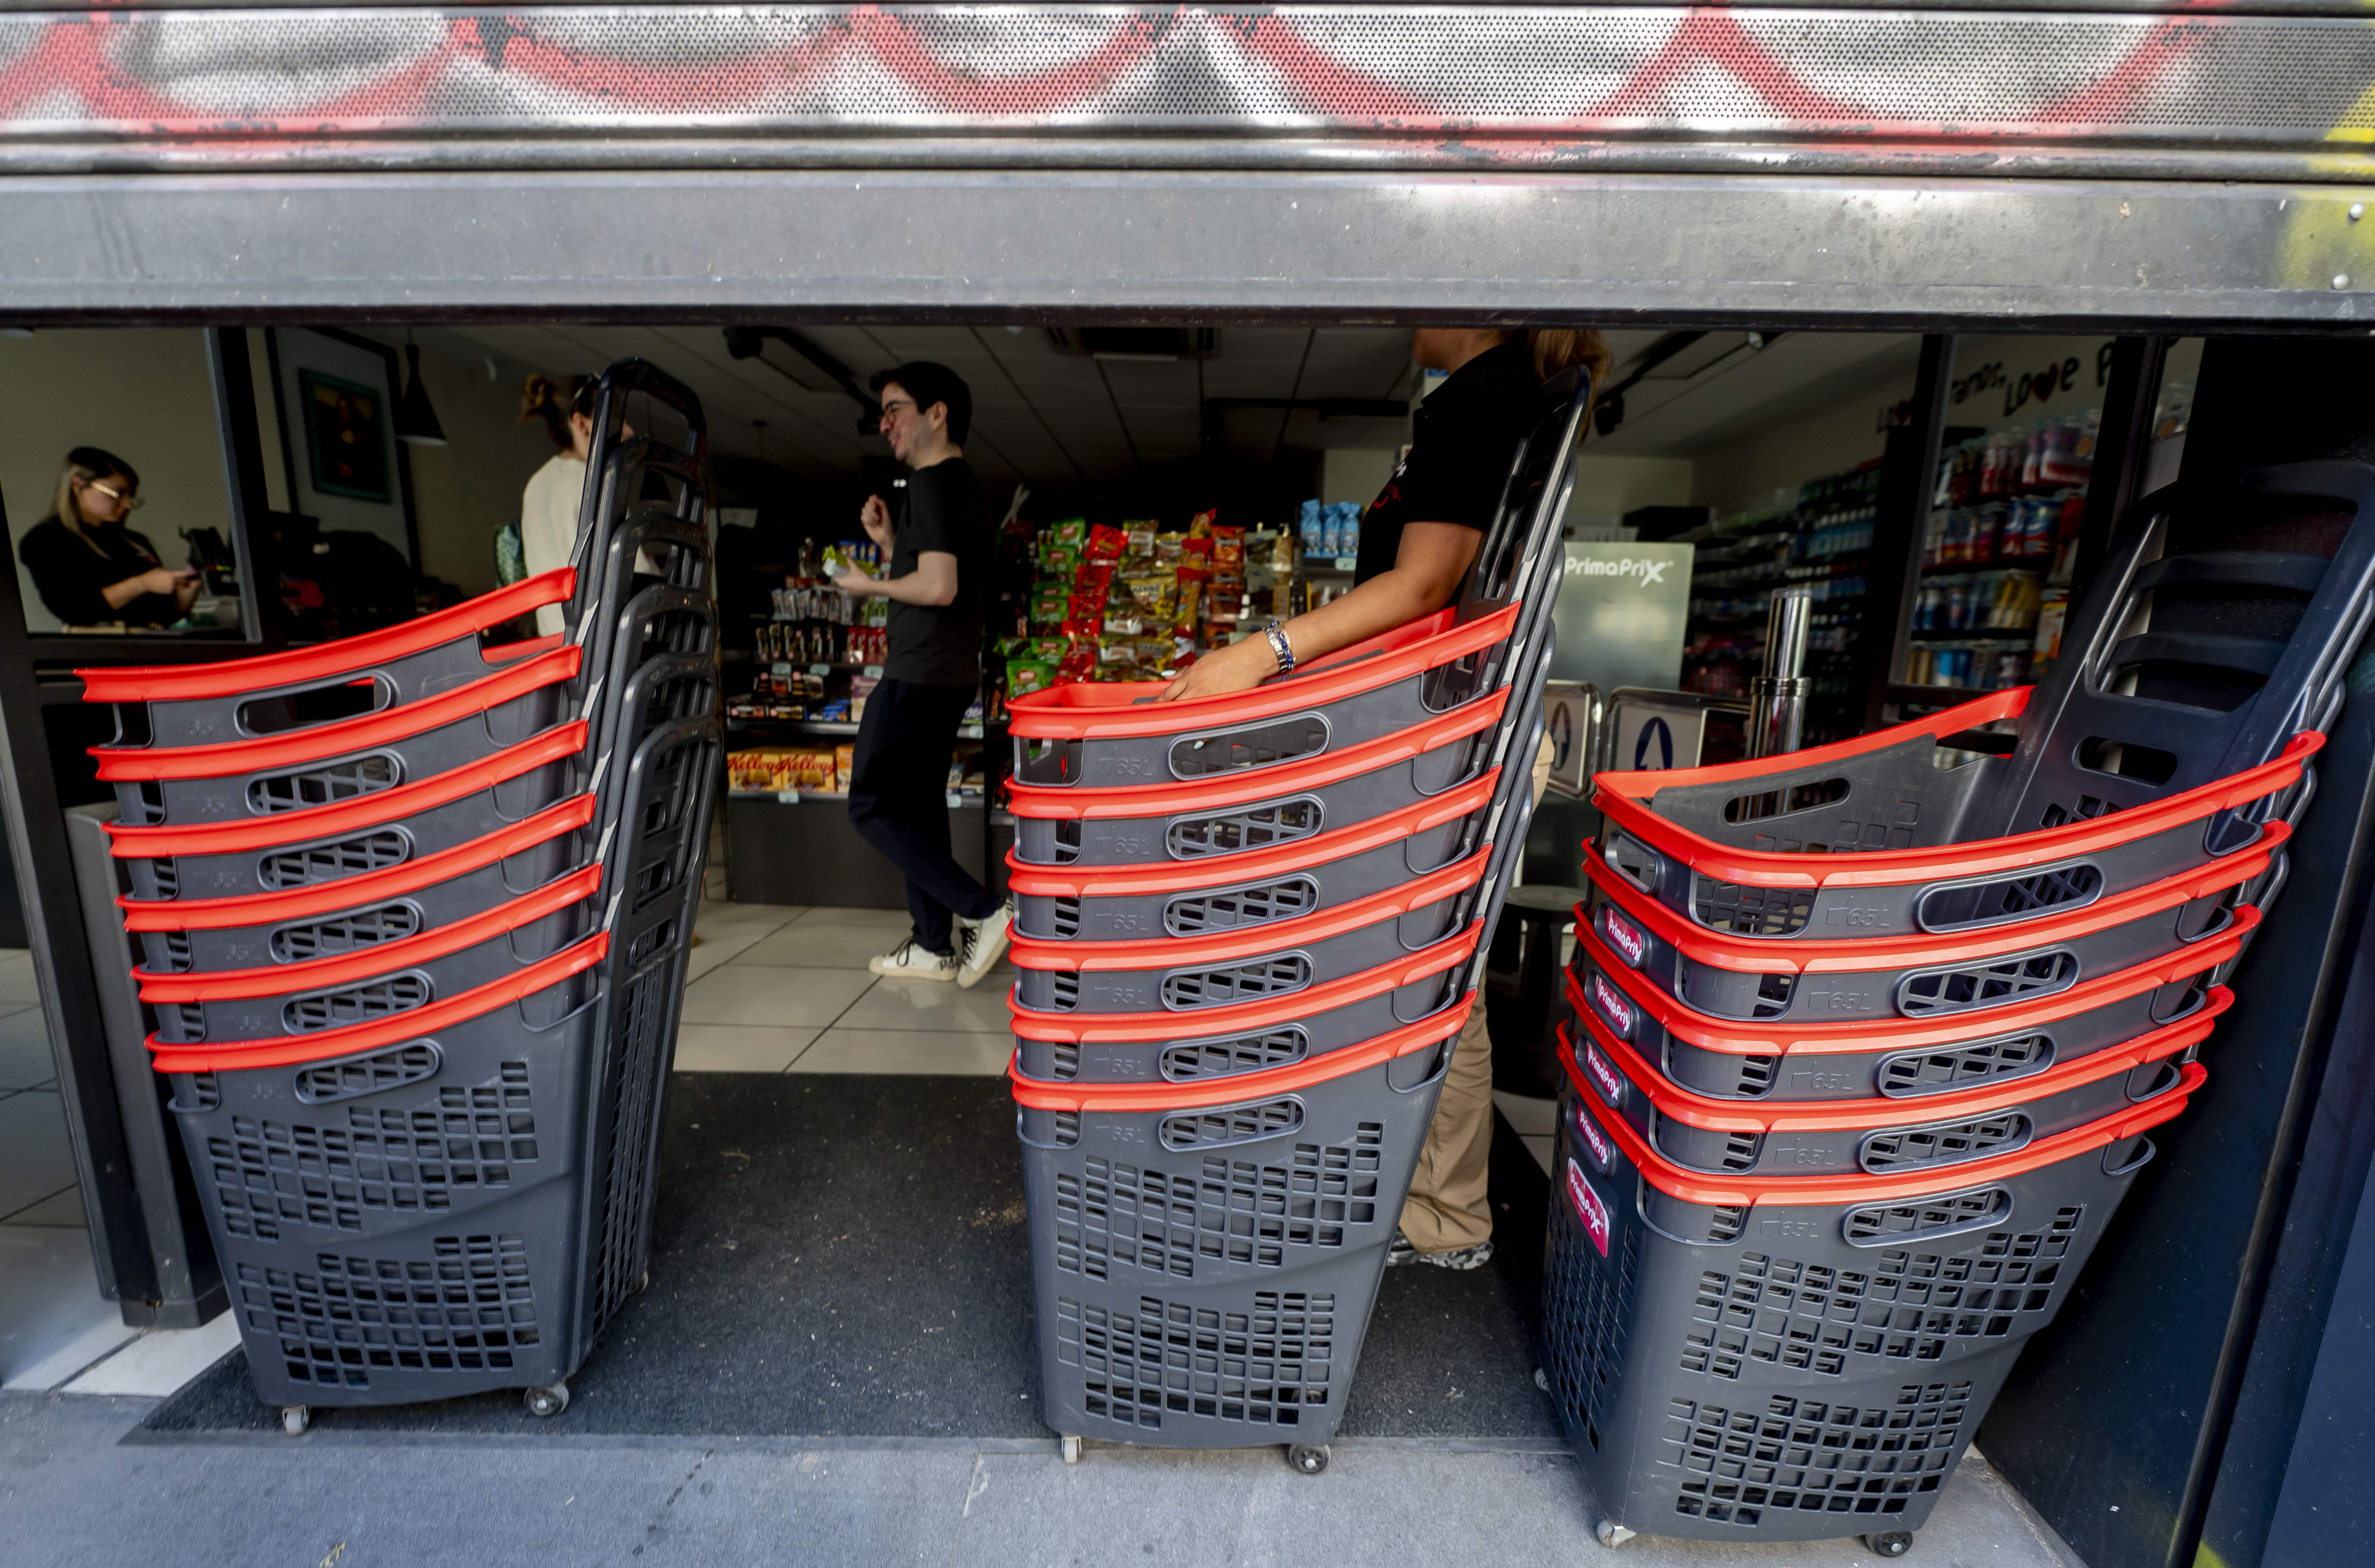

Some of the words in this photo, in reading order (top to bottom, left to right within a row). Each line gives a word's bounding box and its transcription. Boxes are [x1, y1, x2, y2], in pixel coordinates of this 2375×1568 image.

[1846, 908, 1890, 928] 65L
[1828, 991, 1870, 1011] 65L
[1810, 1073, 1852, 1091] 65L
[1793, 1148, 1834, 1166] 65L
[1778, 1221, 1818, 1238] 65L
